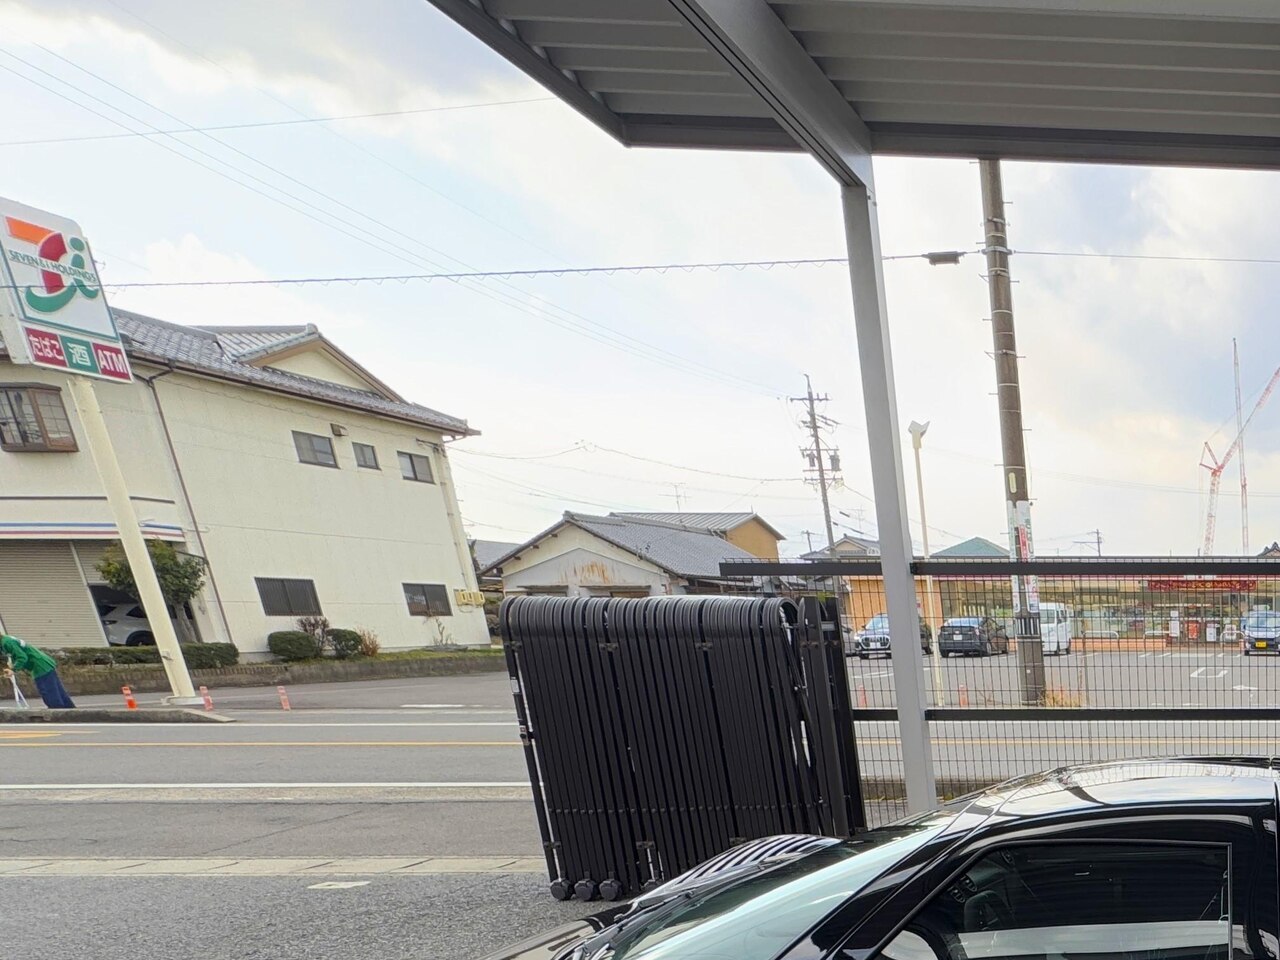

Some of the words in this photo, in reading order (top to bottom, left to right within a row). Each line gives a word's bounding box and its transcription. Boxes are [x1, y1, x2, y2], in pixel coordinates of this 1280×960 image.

[9, 251, 38, 266] SEVEN
[52, 263, 96, 282] HOLDINGS
[29, 334, 64, 361] たばこ
[68, 342, 91, 367] 酒
[97, 349, 127, 374] ATM
